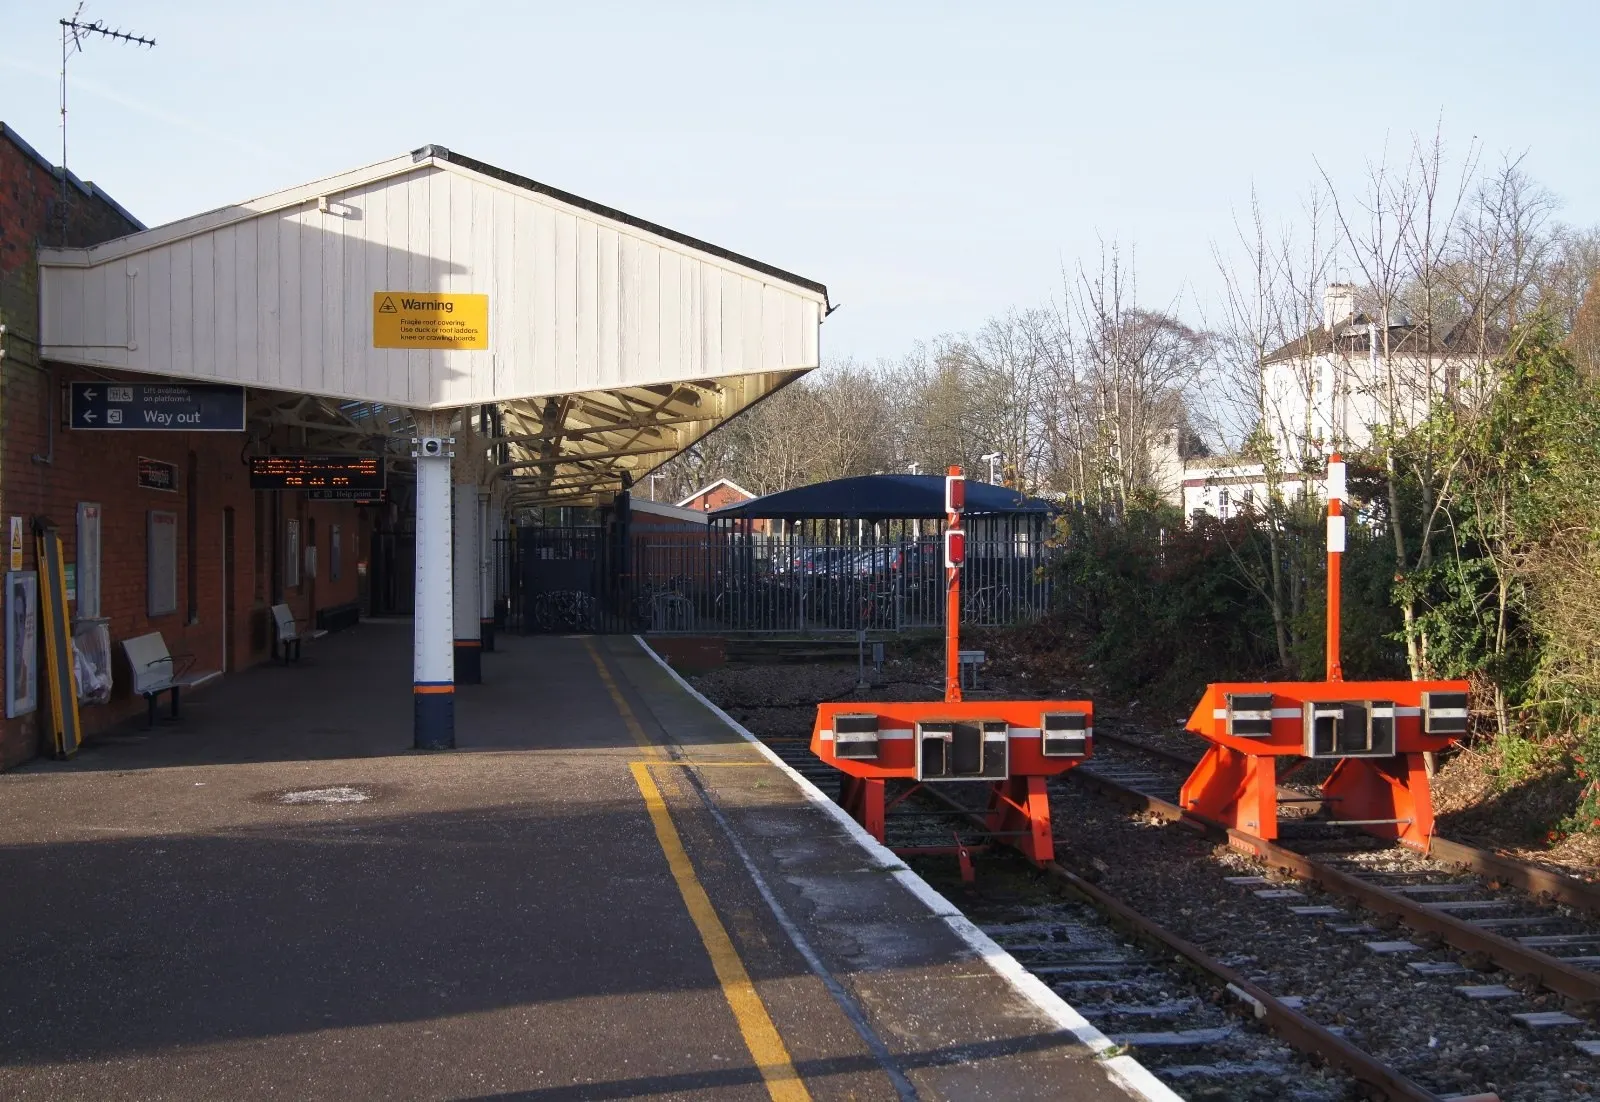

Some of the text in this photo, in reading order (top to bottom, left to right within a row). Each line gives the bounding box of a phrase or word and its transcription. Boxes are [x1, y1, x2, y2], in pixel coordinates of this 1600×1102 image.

[401, 298, 453, 313] Warning
[400, 318, 422, 327] Fragile
[154, 395, 185, 403] platform
[143, 410, 201, 426] Way out
